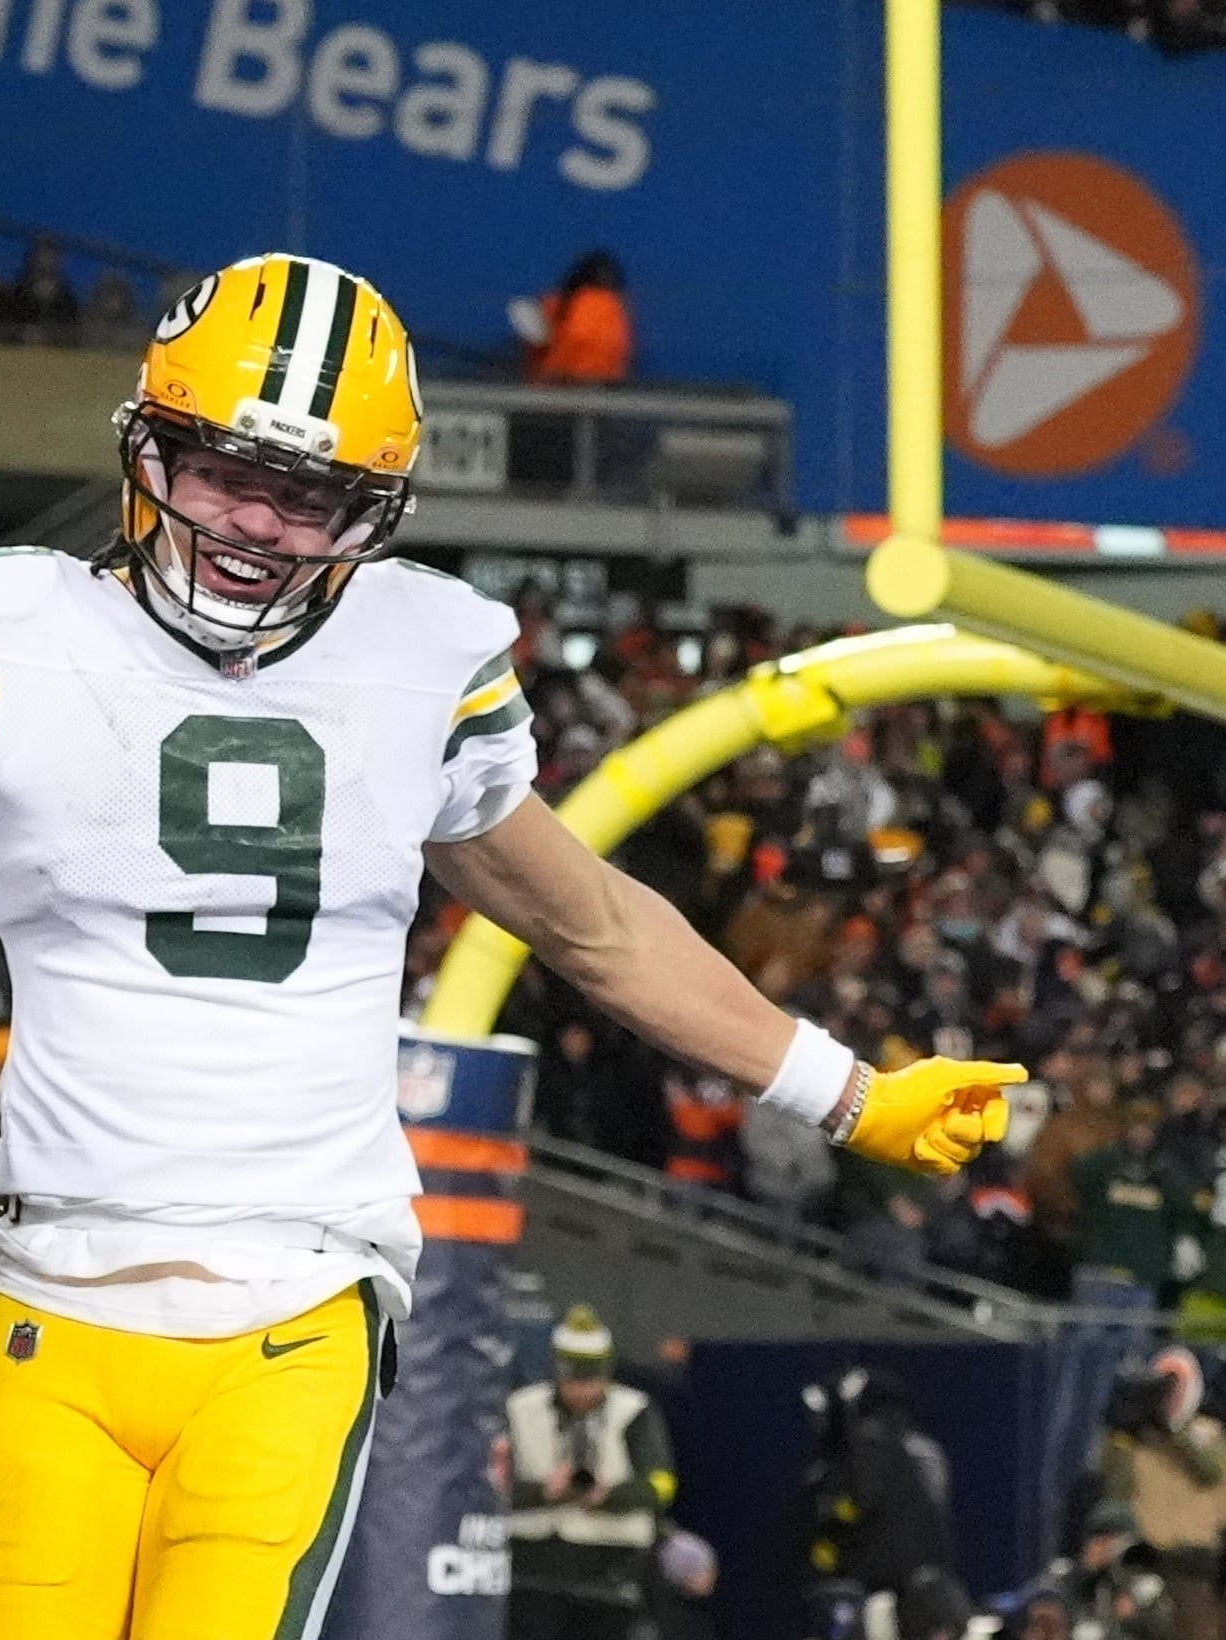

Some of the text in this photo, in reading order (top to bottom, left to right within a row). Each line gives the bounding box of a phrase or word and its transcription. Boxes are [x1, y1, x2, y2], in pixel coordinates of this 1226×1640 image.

[193, 0, 660, 190] Bears
[270, 419, 307, 439] PACKERS
[145, 714, 325, 983] 9
